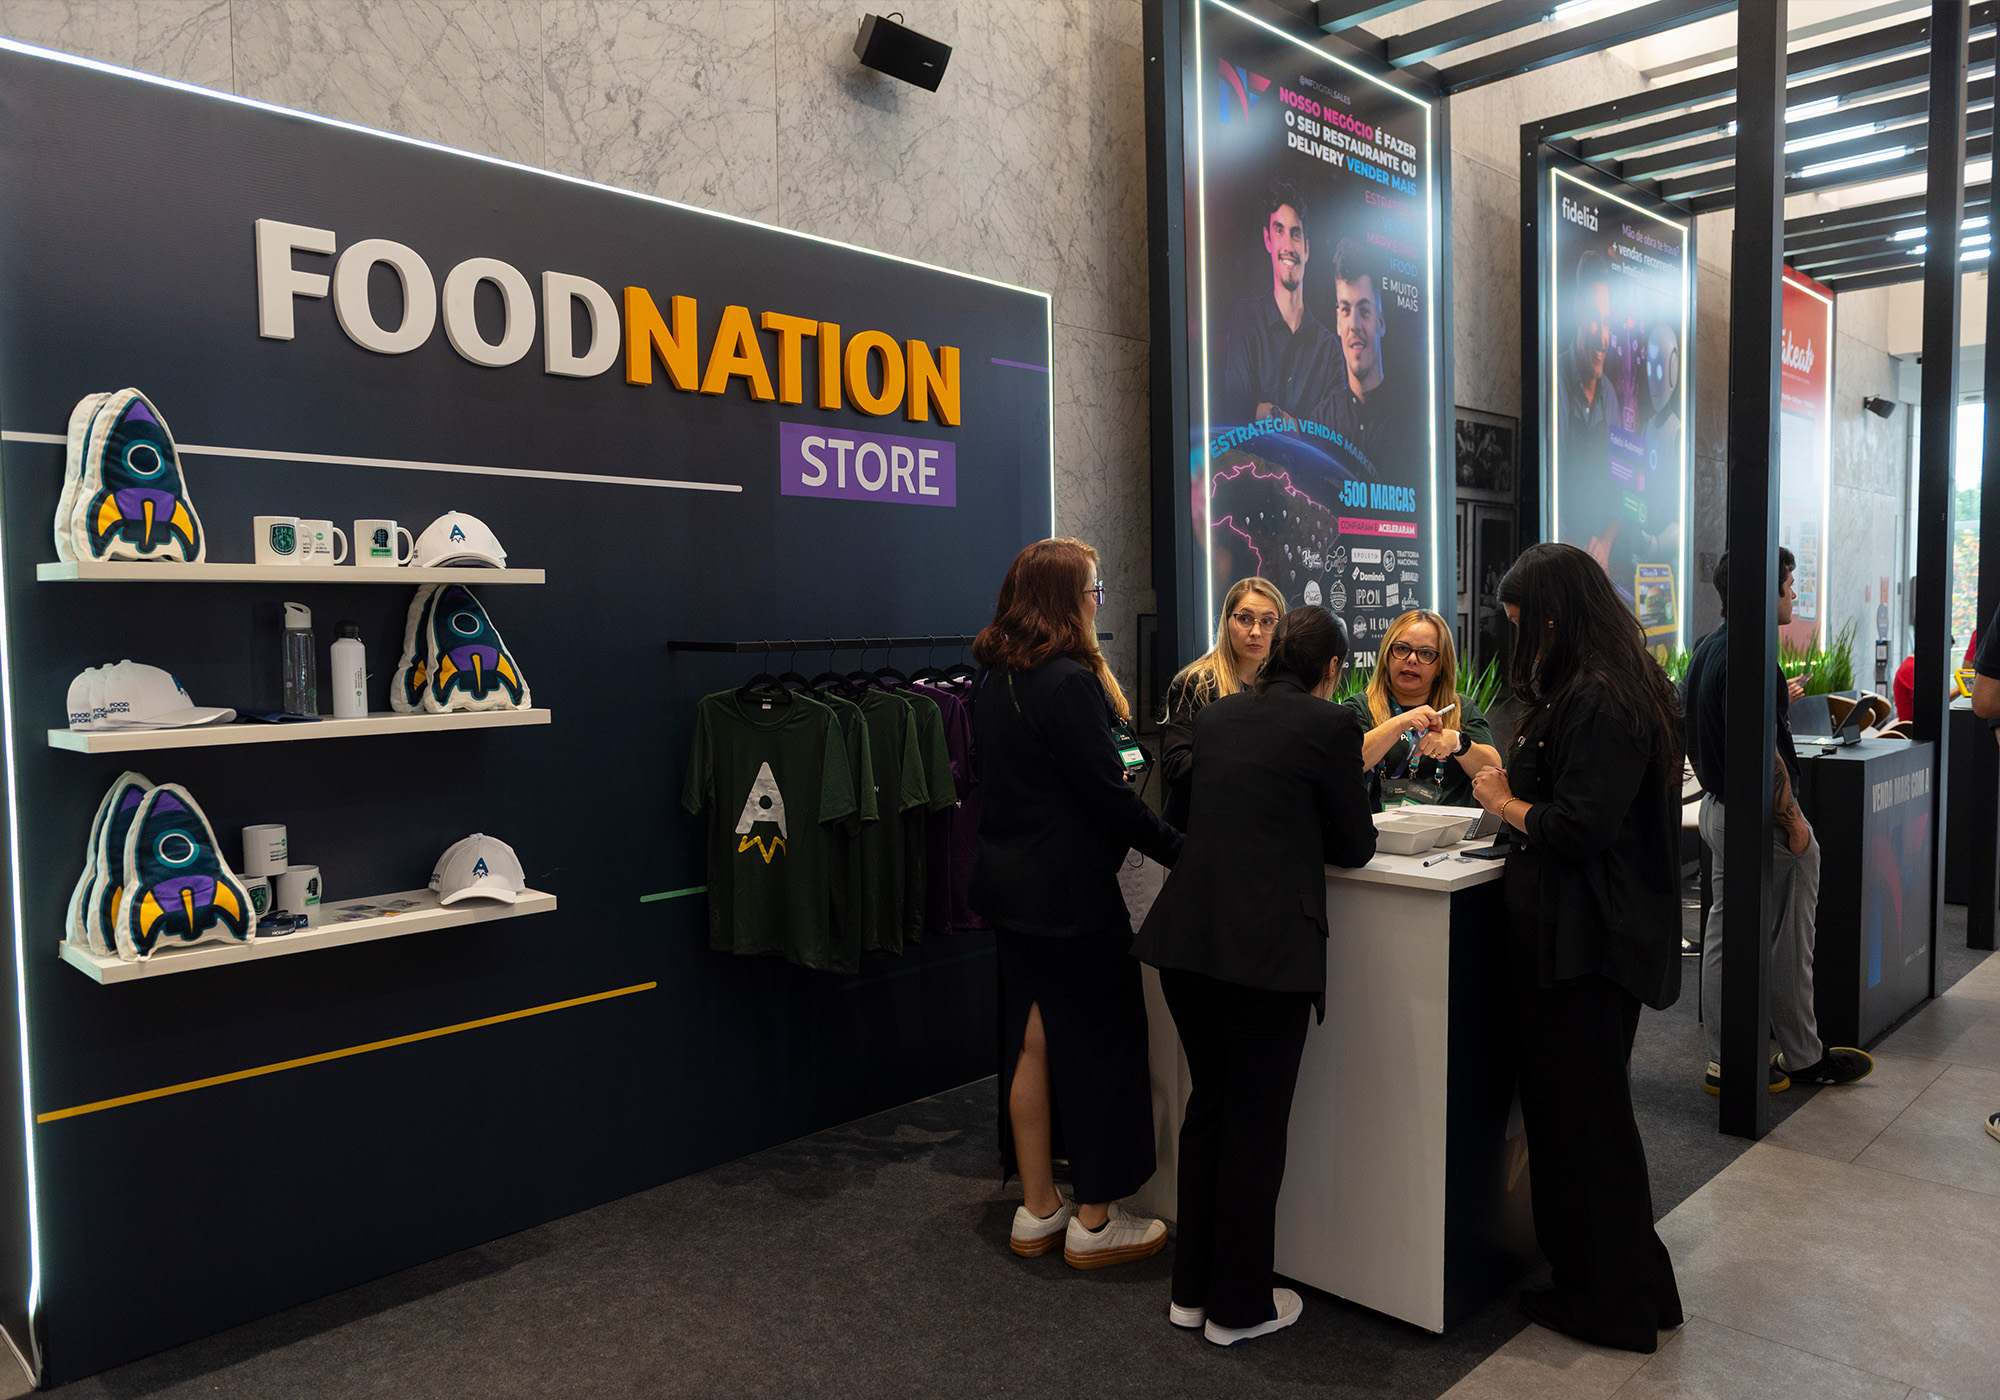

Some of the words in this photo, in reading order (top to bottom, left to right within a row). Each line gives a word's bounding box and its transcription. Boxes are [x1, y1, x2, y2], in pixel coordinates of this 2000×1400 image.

[1279, 86, 1321, 117] NOSSO
[1323, 105, 1374, 140] NEGÓCIO
[1375, 127, 1382, 145] É
[1384, 133, 1416, 160] FAZER
[1285, 110, 1295, 127] O
[1297, 115, 1320, 138] SEU
[1322, 126, 1399, 172] RESTAURANTE
[1401, 160, 1416, 178] OU
[1287, 131, 1344, 167] DELIVERY
[1346, 155, 1389, 186] VENDER
[1391, 174, 1417, 196] MAIS
[1562, 196, 1599, 232] fidelizi
[1622, 223, 1635, 239] Mão
[1636, 230, 1643, 243] de
[1644, 234, 1656, 248] obra
[1618, 244, 1643, 263] vendas
[1382, 276, 1388, 290] E
[1390, 280, 1418, 298] MUITO
[1397, 295, 1418, 312] MAIS
[1209, 415, 1297, 460] ESTRATÉGIA
[1298, 418, 1343, 447] VENDAS
[801, 436, 940, 496] STORE
[1338, 480, 1368, 508] +500
[1370, 483, 1416, 513] MARCAS
[1340, 520, 1374, 532] CONFIARAM
[1378, 523, 1415, 535] ACELERARAM
[1397, 550, 1420, 559] TRATTORIA
[1872, 779, 1893, 813] VENDA
[1894, 773, 1910, 805] MAIS
[1911, 769, 1925, 799] COM
